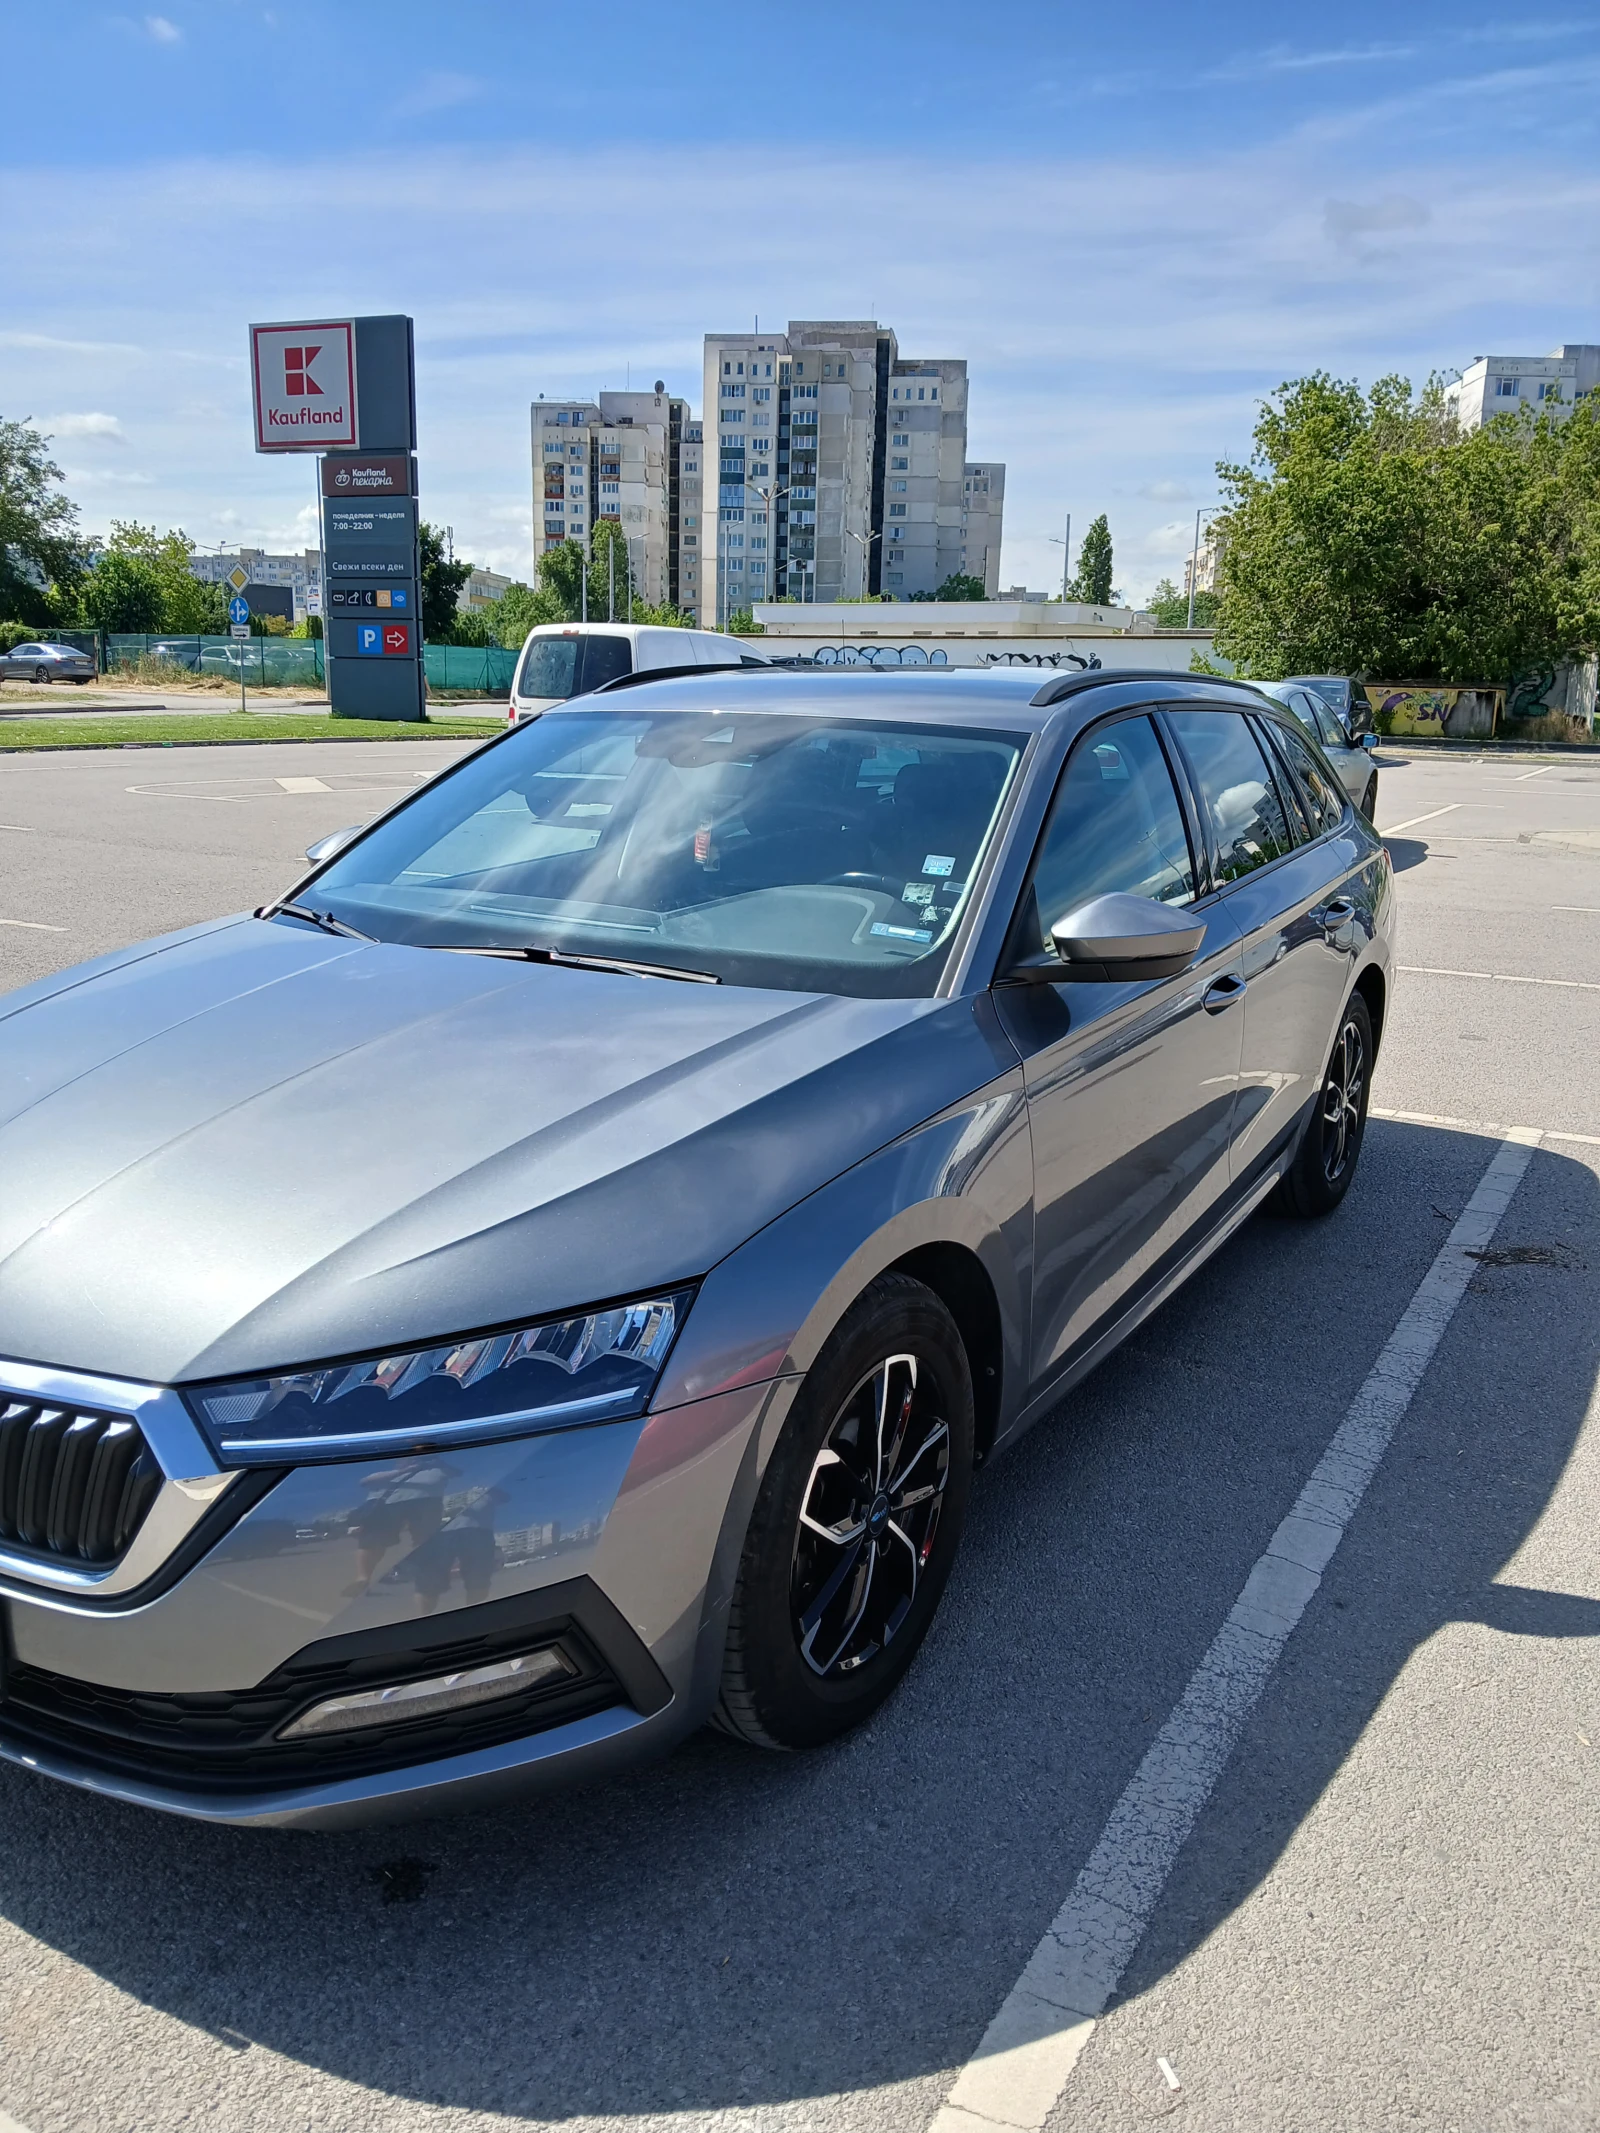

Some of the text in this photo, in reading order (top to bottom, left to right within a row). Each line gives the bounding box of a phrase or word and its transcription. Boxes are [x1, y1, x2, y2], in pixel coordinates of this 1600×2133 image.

[284, 346, 325, 395] K
[268, 406, 344, 426] Kaufland
[352, 468, 386, 477] Kaufland
[352, 476, 394, 488] пекарна
[332, 561, 404, 572] Свежи всеки ден
[363, 629, 376, 649] P
